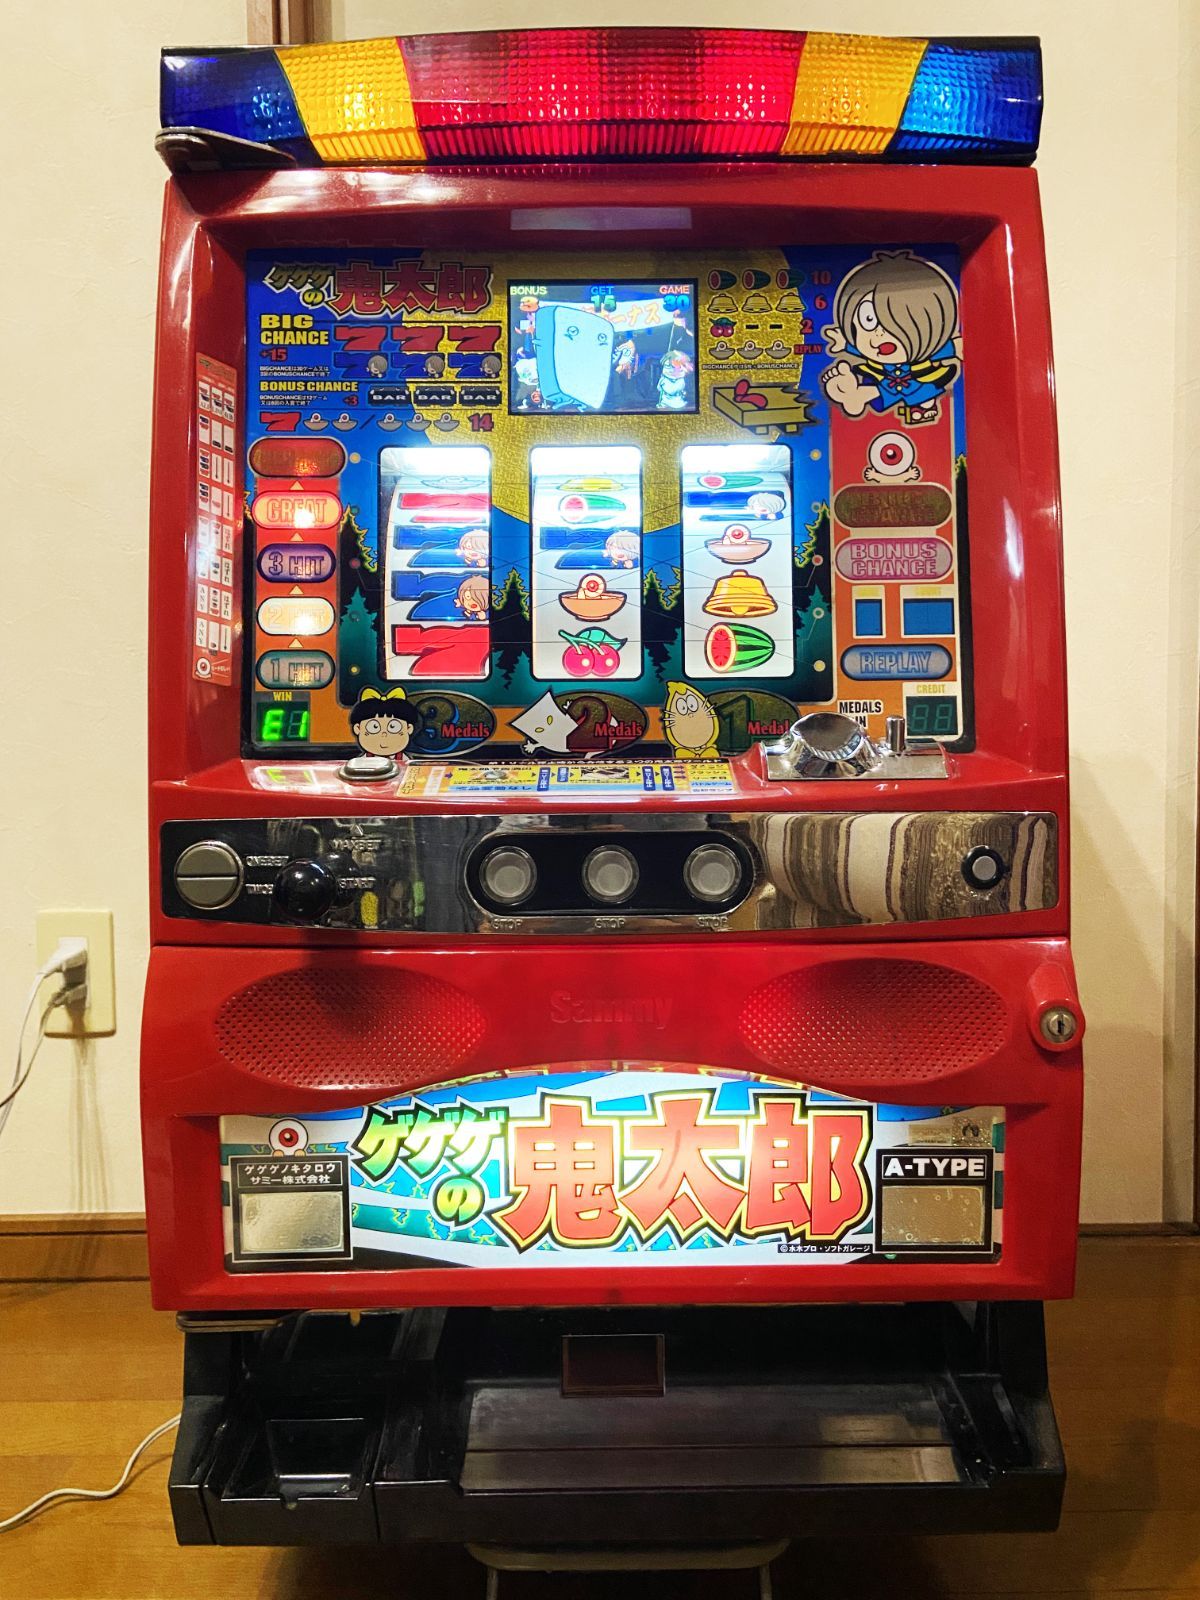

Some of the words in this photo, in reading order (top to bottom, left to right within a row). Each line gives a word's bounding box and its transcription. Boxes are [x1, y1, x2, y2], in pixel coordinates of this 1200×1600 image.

[327, 262, 492, 314] 鬼太郎
[510, 286, 547, 296] BONUS
[590, 286, 614, 295] GET
[659, 285, 690, 295] GAME
[590, 295, 617, 312] 15
[662, 294, 691, 312] 30
[261, 315, 313, 329] BIG
[260, 330, 329, 346] CHANCE
[260, 381, 305, 391] BONUS
[306, 381, 358, 391] CHANCE
[468, 413, 495, 431] 14
[266, 499, 327, 523] GREAT
[850, 542, 938, 560] BONUS
[268, 551, 283, 576] 3
[288, 555, 325, 576] HIT
[851, 558, 938, 577] CHANCE
[860, 652, 932, 674] REPLAY
[288, 662, 323, 682] HIT
[273, 691, 292, 702] WIN
[916, 684, 946, 694] CREDIT
[839, 700, 882, 713] MEDALS
[441, 722, 490, 738] Medals
[594, 722, 643, 738] Medals
[747, 721, 790, 735] Medal
[492, 919, 523, 929] STOP
[594, 918, 626, 928] STOP
[697, 917, 728, 927] STOP
[550, 990, 672, 1030] Sammy
[244, 1163, 336, 1175] ゲゲゲノキタロウ
[357, 1108, 506, 1176] ゲゲゲ
[434, 1176, 484, 1222] の
[502, 1096, 872, 1240] 鬼太郎
[884, 1158, 985, 1177] A-TYPE
[250, 1174, 331, 1185] サミー株式会社
